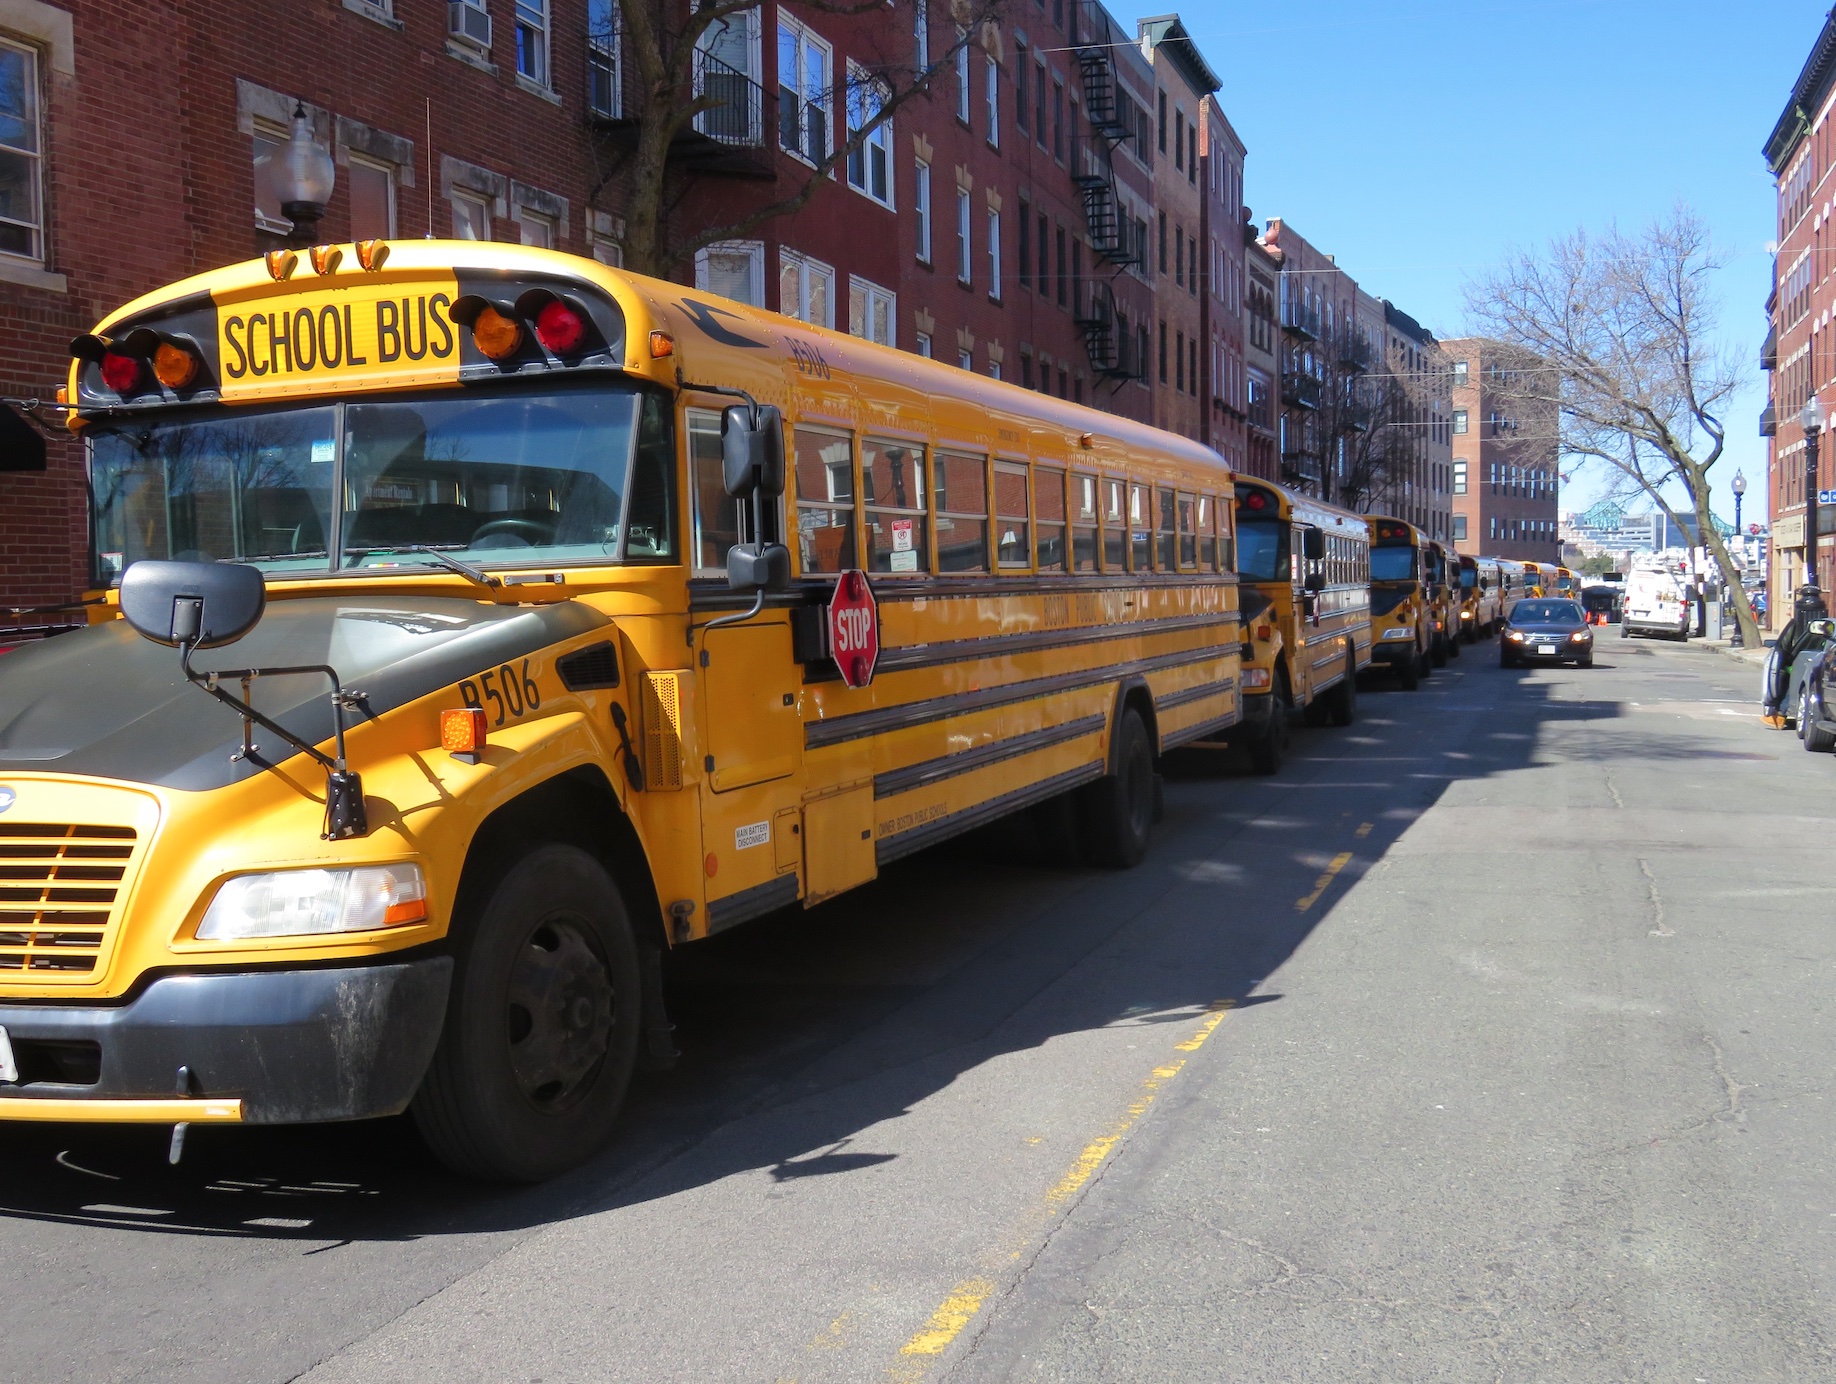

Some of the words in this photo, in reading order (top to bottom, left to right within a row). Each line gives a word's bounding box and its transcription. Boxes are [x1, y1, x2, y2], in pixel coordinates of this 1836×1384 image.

[224, 304, 367, 379] SCHOOL
[376, 292, 454, 364] BUS
[1044, 595, 1069, 627] BOSTON
[1076, 594, 1097, 624] PUBLIC
[837, 607, 871, 652] STOP
[737, 828, 748, 839] MAIN
[749, 823, 768, 835] BATTERY
[897, 813, 914, 831] BOSTON
[914, 807, 929, 824] PUBLIC
[929, 800, 947, 820] SCHOOLS
[738, 832, 768, 848] DISCONNECT
